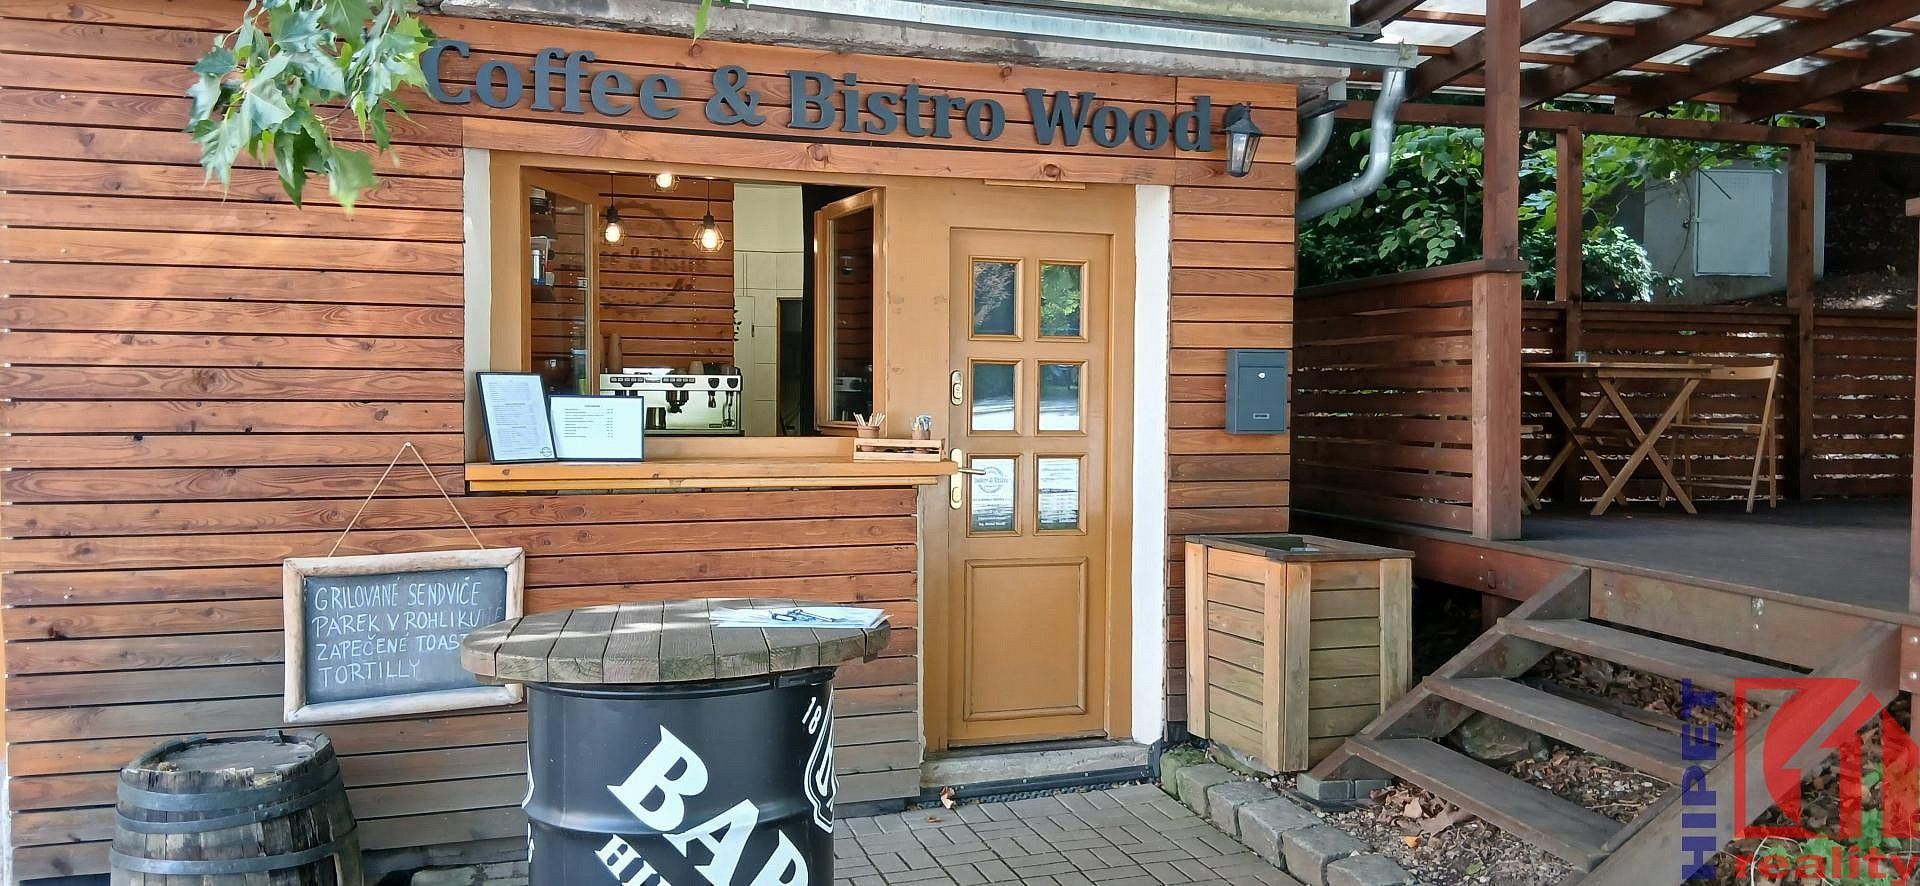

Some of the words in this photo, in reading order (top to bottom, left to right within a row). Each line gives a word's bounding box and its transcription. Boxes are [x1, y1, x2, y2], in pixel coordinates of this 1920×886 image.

[422, 38, 681, 120] Coffee
[705, 64, 767, 126] &
[786, 69, 1006, 141] Bistro
[1023, 87, 1215, 153] Wood
[315, 576, 400, 611] GRILOVANÉ
[408, 576, 481, 606] SENDVIČE
[311, 612, 382, 638] PÁREK
[387, 614, 400, 632] V
[316, 633, 409, 661] ZAPEČENÉ
[318, 658, 420, 688] TORTILLY
[802, 697, 822, 735] 18
[594, 834, 672, 886] HI
